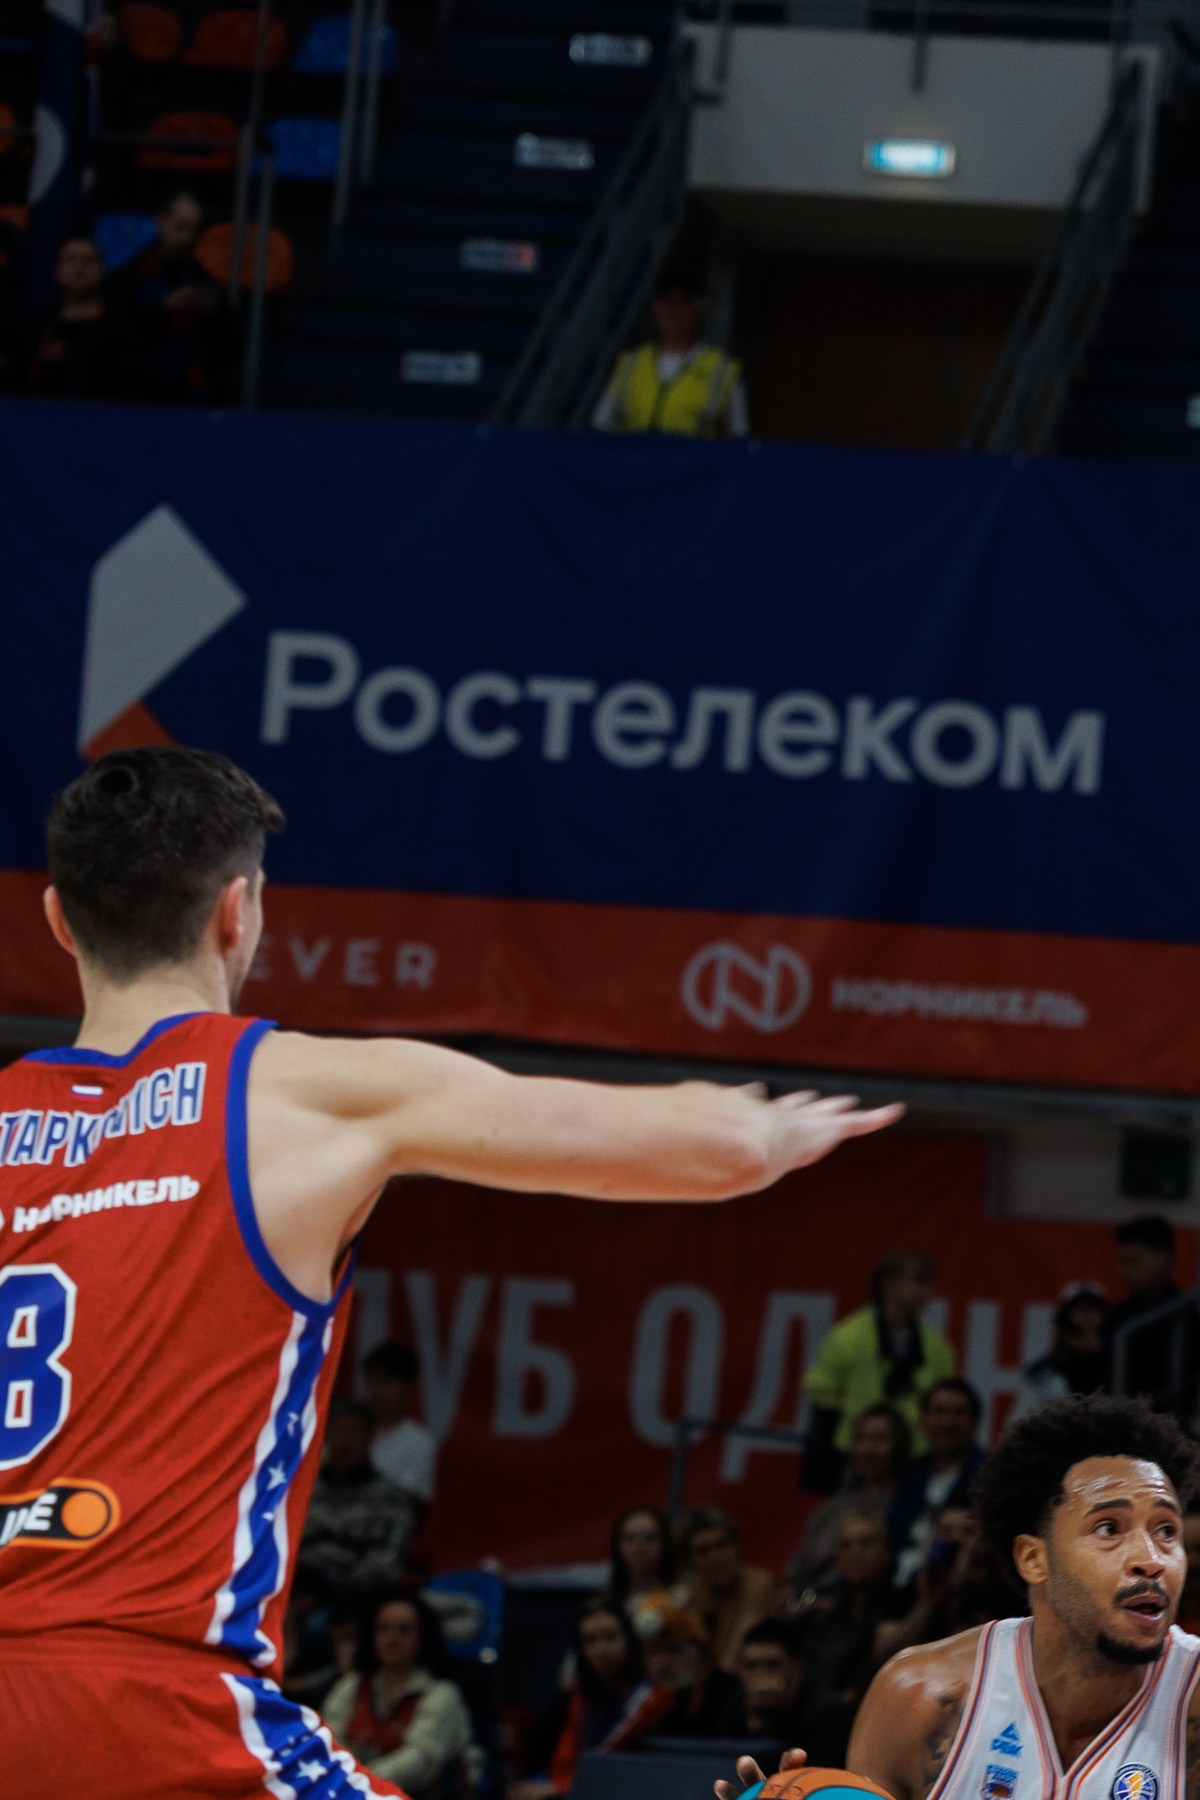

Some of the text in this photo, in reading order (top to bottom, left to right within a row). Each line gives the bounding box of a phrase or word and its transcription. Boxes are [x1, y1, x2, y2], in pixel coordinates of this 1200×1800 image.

[261, 629, 1106, 796] Ростелеком
[829, 976, 1090, 1029] НОРНИКЕЛЬ
[0, 1261, 78, 1473] 8
[630, 1281, 1062, 1483] ОДН
